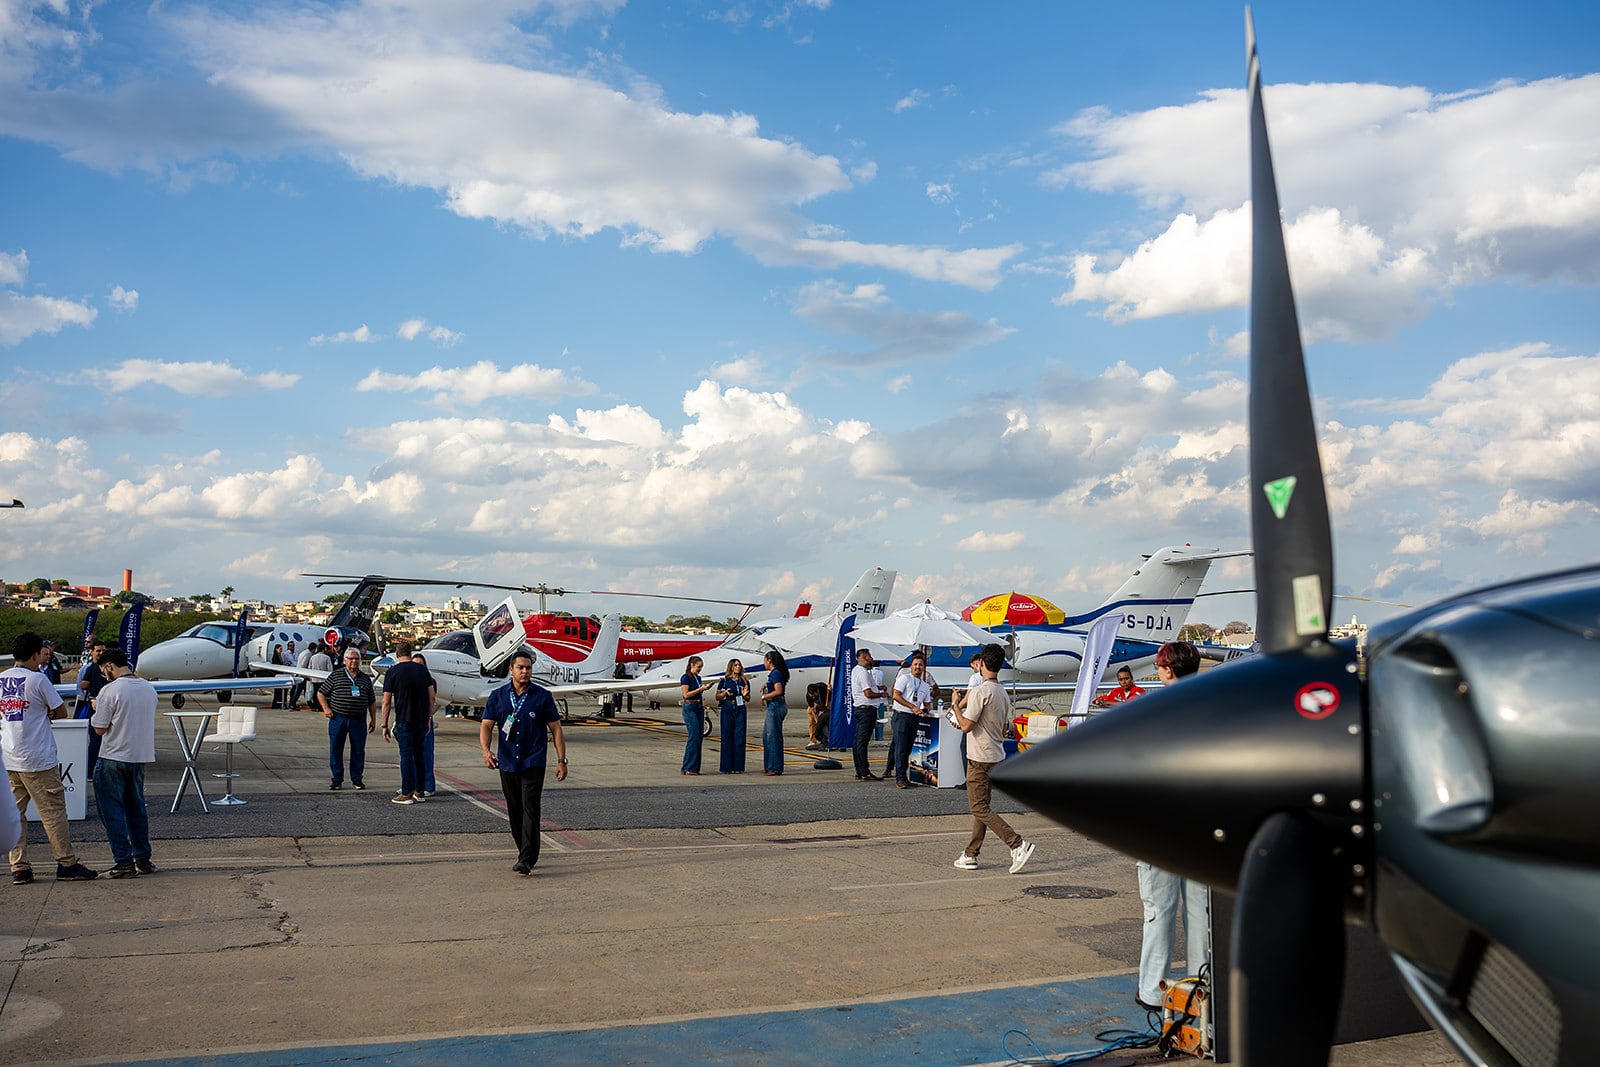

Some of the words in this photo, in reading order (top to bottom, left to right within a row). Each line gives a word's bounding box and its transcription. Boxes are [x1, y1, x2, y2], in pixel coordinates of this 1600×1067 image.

[843, 602, 886, 615] PS-ETM
[623, 648, 654, 656] PR-WBI
[550, 665, 580, 684] PP-UEM
